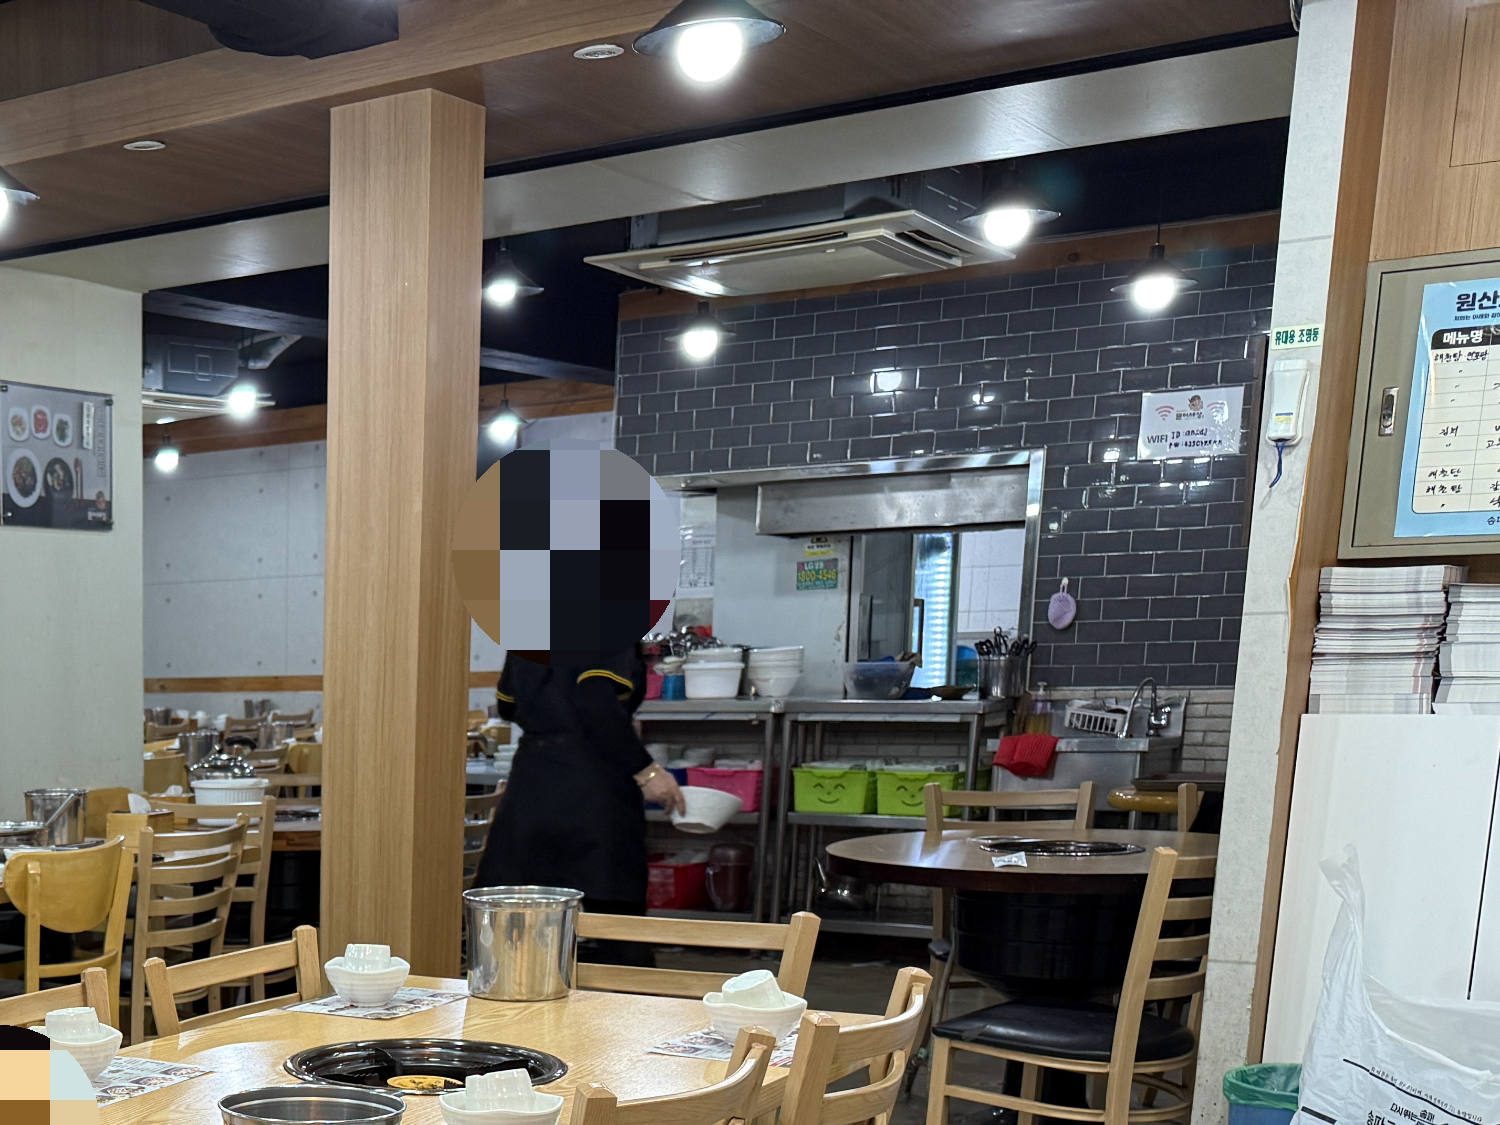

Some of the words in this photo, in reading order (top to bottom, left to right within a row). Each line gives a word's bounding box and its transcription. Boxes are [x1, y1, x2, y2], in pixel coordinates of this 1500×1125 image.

[1456, 290, 1500, 312] 원산
[1275, 330, 1296, 345] 휴대용
[1298, 328, 1319, 342] 조명등
[1443, 330, 1483, 345] 메뉴명
[1147, 434, 1168, 443] WIFI
[1171, 431, 1180, 439] ID
